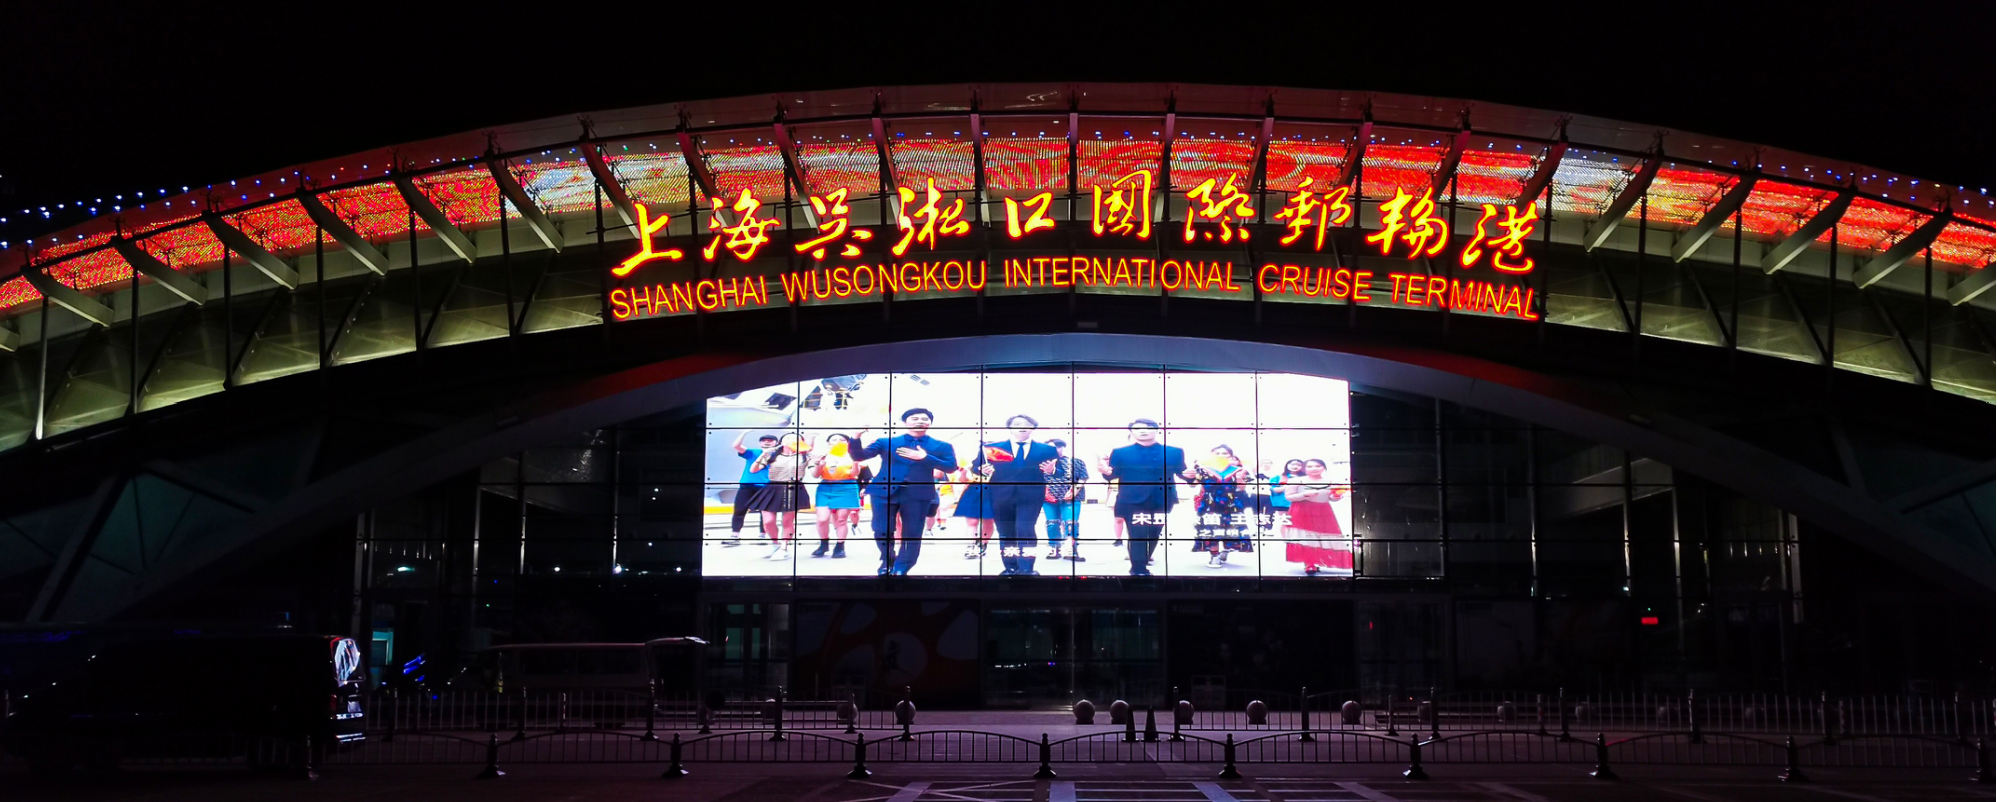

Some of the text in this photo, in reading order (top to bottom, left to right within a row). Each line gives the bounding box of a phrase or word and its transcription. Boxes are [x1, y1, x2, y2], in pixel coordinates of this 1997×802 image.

[610, 256, 1538, 320] SHANGHAI WUSONGKOU INTERNATIONAL CRUISE TERMINAL
